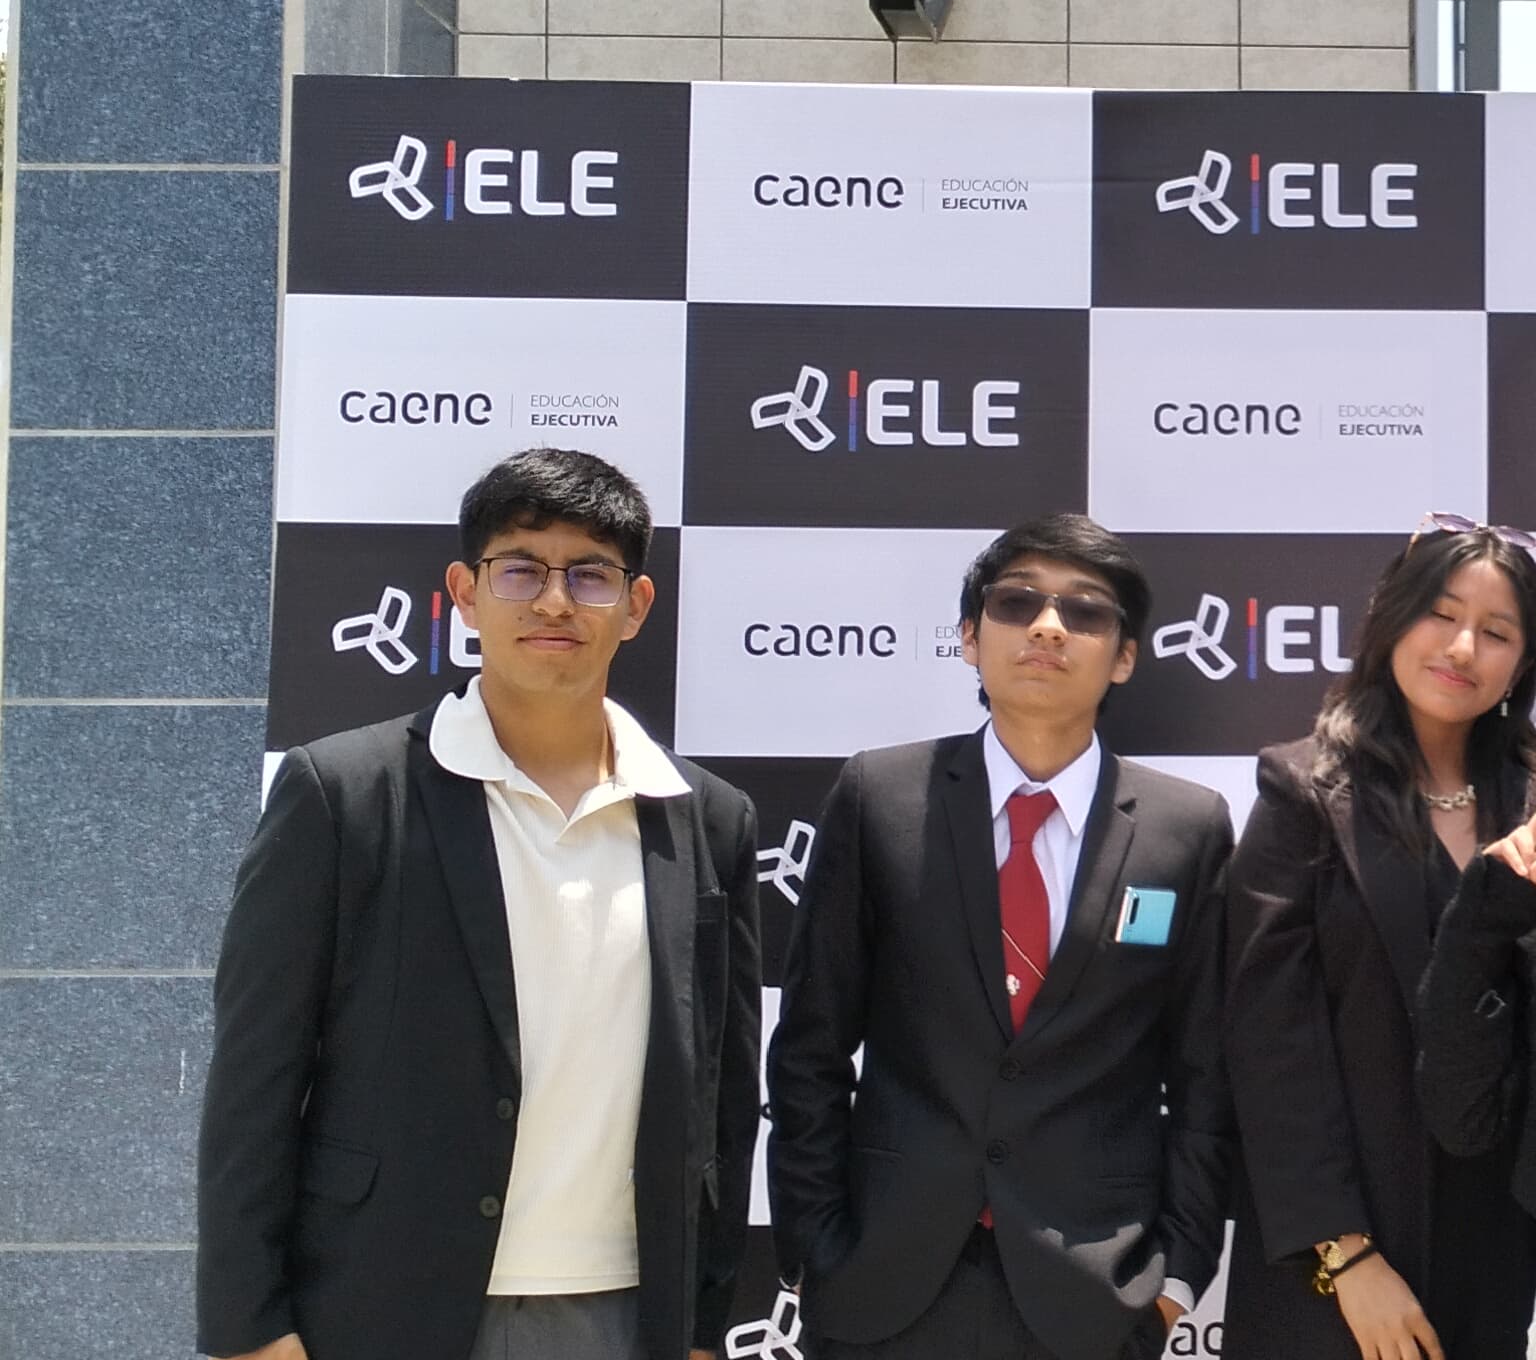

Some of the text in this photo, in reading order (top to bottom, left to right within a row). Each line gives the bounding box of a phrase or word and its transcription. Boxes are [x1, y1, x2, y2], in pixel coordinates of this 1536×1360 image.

[464, 148, 619, 216] ELE
[753, 174, 905, 209] caene
[941, 177, 1029, 193] EDUCACIÓN
[1268, 162, 1419, 228] ELE
[942, 197, 1028, 211] EJECUTIVA
[340, 390, 493, 426] caene
[530, 393, 620, 409] EDUCACIÓN
[866, 379, 1020, 447] ELE
[1338, 402, 1425, 418] EDUCACIÓN
[531, 413, 618, 427] EJECUTIVA
[1153, 402, 1302, 436] caene
[1339, 422, 1423, 437] EJECUTIVA
[744, 623, 897, 658] caene
[1265, 605, 1355, 672] EL
